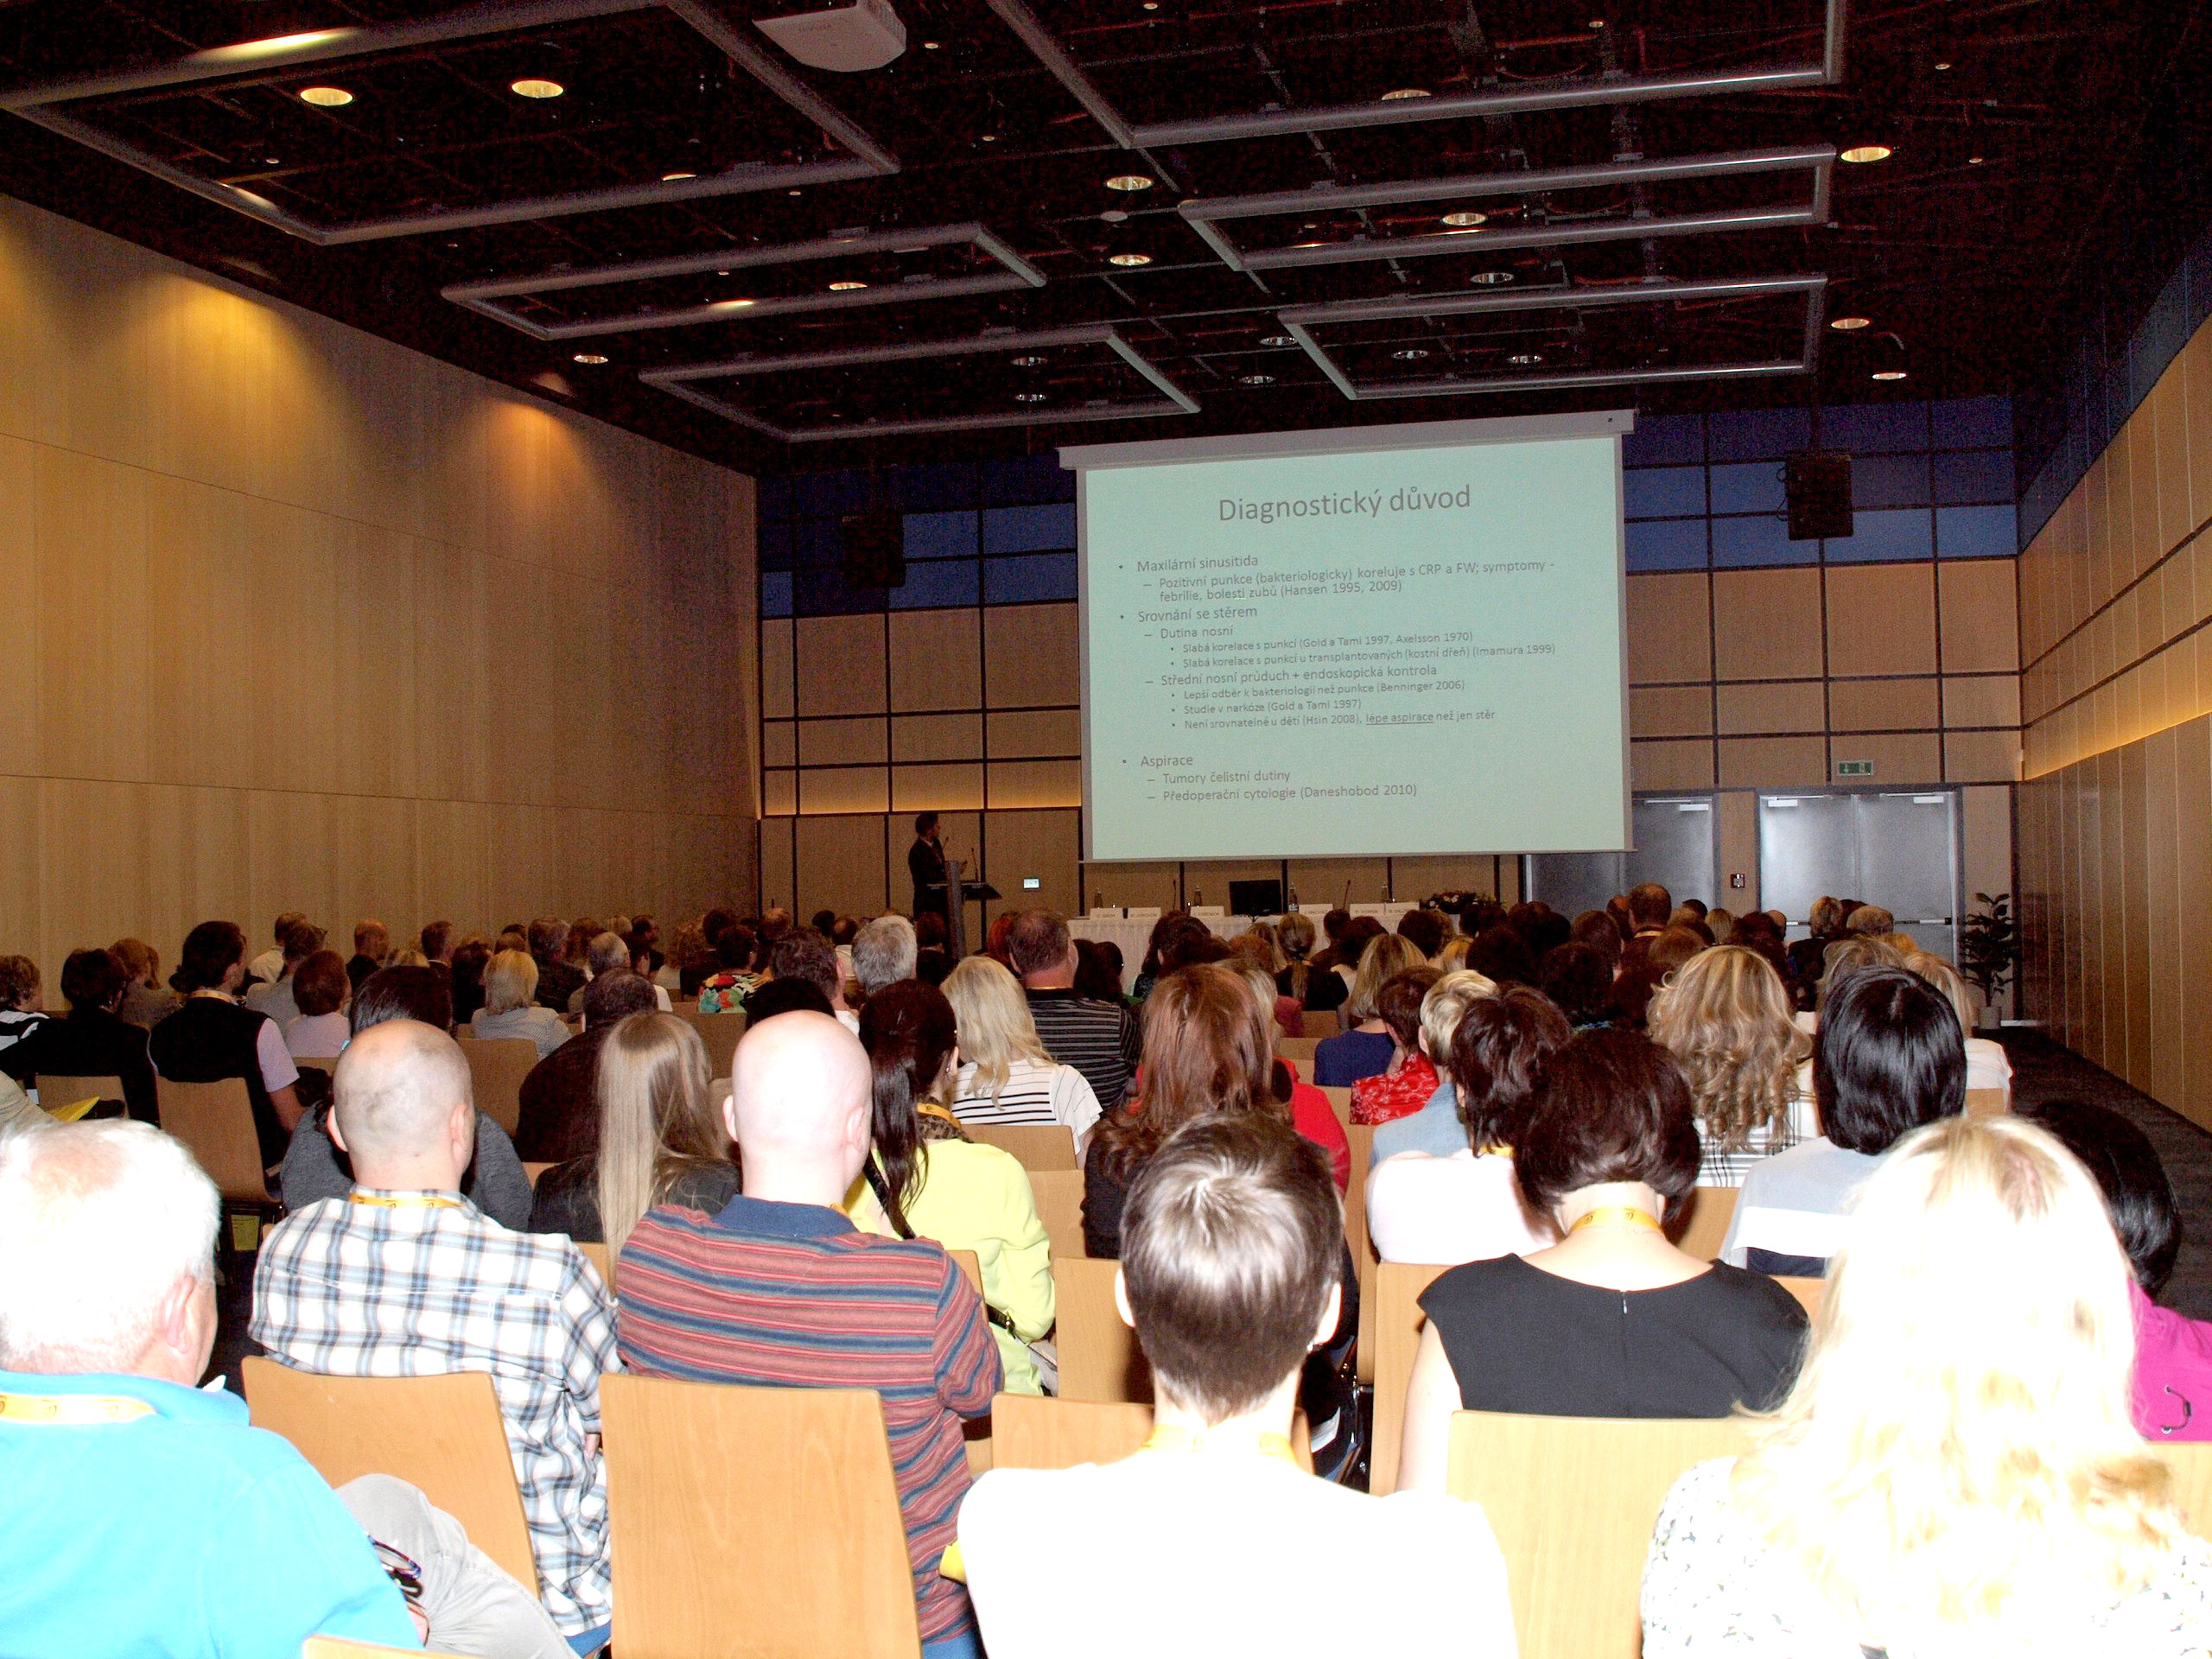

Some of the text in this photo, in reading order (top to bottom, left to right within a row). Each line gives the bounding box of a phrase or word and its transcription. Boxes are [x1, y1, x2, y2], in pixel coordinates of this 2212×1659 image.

[1219, 484, 1471, 524] Diagnostický důvod
[1137, 556, 1258, 572] Maxilární sinusitida
[1160, 575, 1206, 588] Pozitivní
[1211, 575, 1252, 587] punkce
[1255, 569, 1352, 585] (bakteriologicky)
[1357, 567, 1406, 579] koreluje
[1419, 564, 1441, 575] CRP
[1457, 563, 1479, 575] FW;
[1483, 561, 1546, 573] symptomy
[1160, 580, 1402, 602] febrilie, bolesti zubů (Hansen 1995, 2009)
[1138, 606, 1258, 622] Srovnání se stěrem
[1160, 625, 1234, 639] Dutina nosní
[1183, 642, 1210, 653] Slabá
[1212, 641, 1254, 652] korelace
[1264, 638, 1297, 651] punkcí
[1299, 639, 1327, 650] (Gold
[1338, 636, 1362, 645] Tami
[1395, 633, 1440, 644] Axelsson
[1444, 632, 1473, 642] 1970)
[1183, 657, 1210, 668] Slabá
[1212, 656, 1255, 667] korelace
[1264, 653, 1297, 665] punkcí
[1309, 649, 1402, 663] transplantovaných
[1404, 647, 1440, 659] (kostní
[1442, 645, 1470, 658] dřeň)
[1472, 646, 1523, 658] (Imamura
[1527, 644, 1555, 655] 1999)
[1161, 673, 1202, 686] Střední
[1206, 672, 1237, 683] nosní
[1241, 668, 1289, 684] průduch
[1303, 664, 1383, 680] endoskopická
[1387, 664, 1437, 677] kontrola
[1184, 690, 1209, 702] Lepší
[1211, 688, 1242, 699] odběr
[1252, 685, 1315, 697] bakteriologii
[1317, 685, 1335, 695] než
[1338, 683, 1374, 694] punkce
[1376, 682, 1433, 693] (Benninger
[1436, 680, 1465, 690] 2006)
[1184, 704, 1216, 715] Studie
[1226, 702, 1265, 713] narkóze
[1267, 701, 1295, 712] (Gold
[1333, 699, 1362, 709] 1997)
[1185, 720, 1208, 729] Není
[1209, 715, 1269, 728] srovnatelné
[1302, 715, 1328, 726] (Hsin
[1331, 712, 1363, 724] 2008),
[1366, 713, 1389, 725] lépe
[1391, 713, 1434, 724] aspirace
[1436, 712, 1454, 721] než
[1456, 711, 1473, 722] jen
[1475, 709, 1496, 719] stěr
[1141, 755, 1193, 767] Aspirace
[1162, 770, 1291, 785] Tumory čelistní dutiny
[1162, 784, 1417, 802] Předoperační cytologie (Daneshobod 2010)
